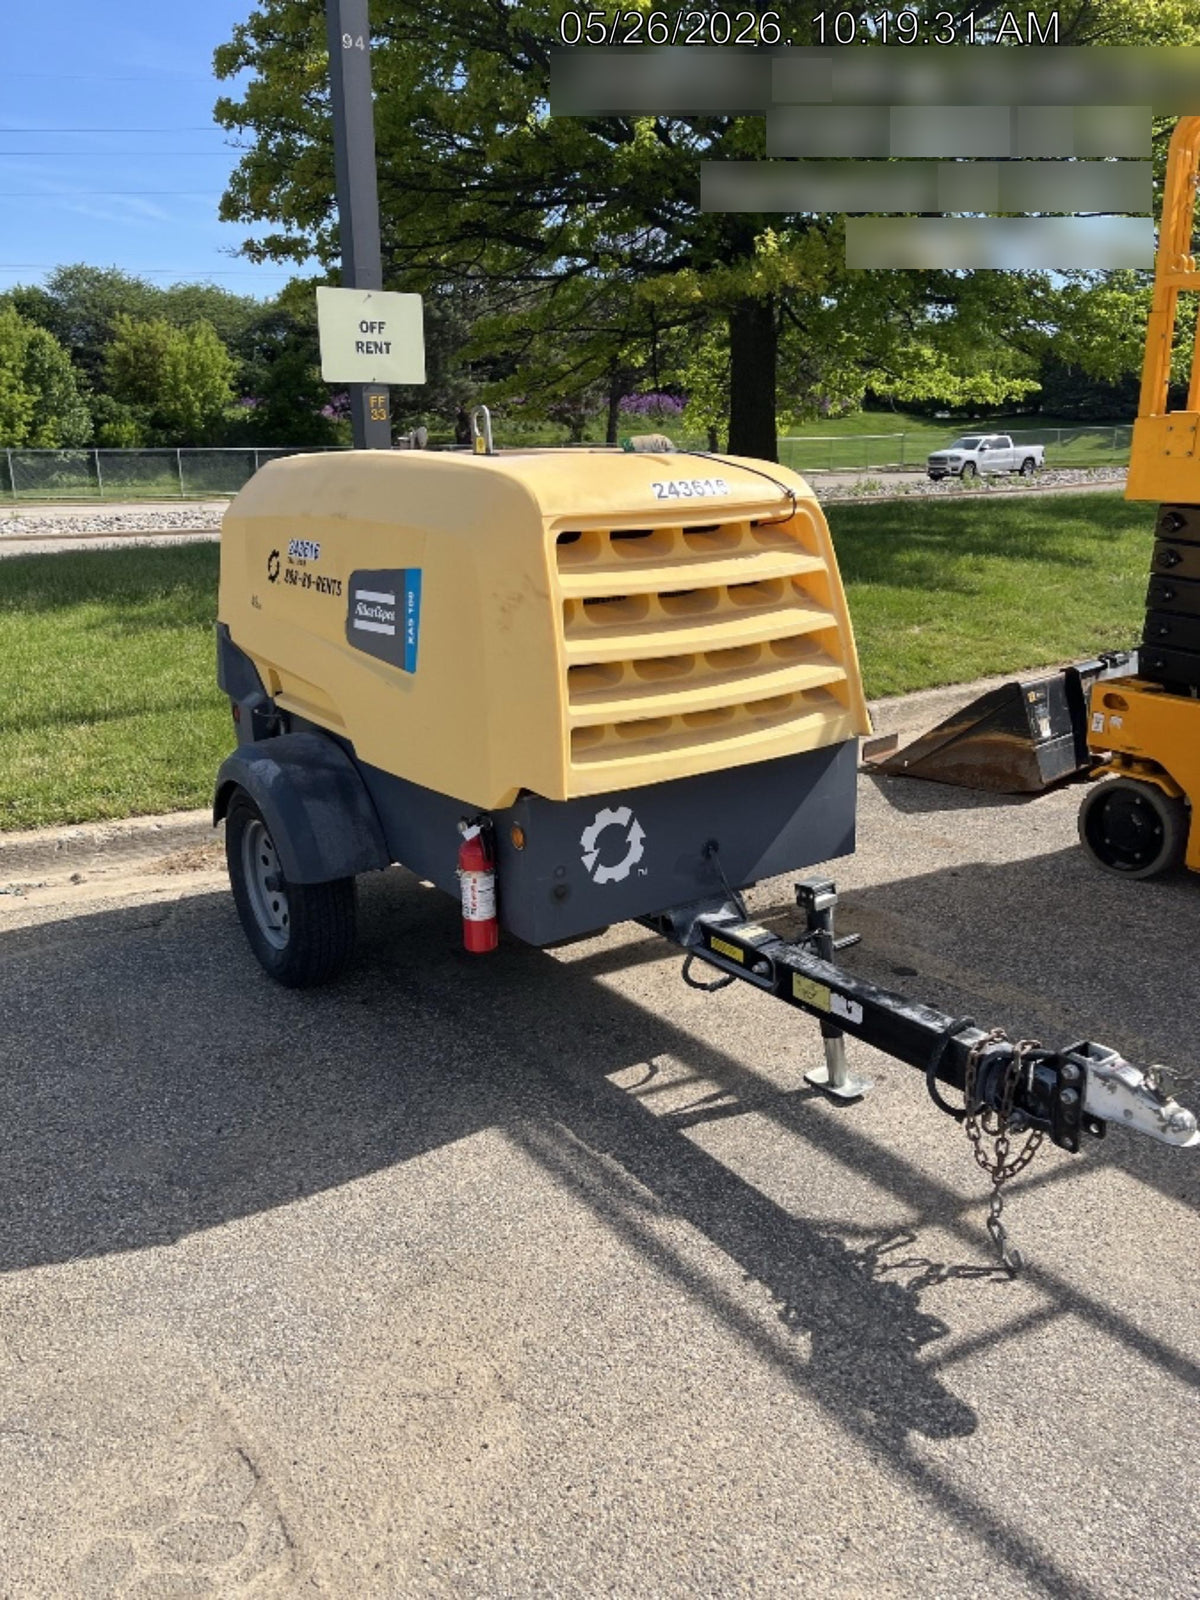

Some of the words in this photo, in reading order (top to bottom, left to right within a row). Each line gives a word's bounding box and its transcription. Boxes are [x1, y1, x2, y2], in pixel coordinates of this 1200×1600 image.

[342, 33, 365, 51] 94
[359, 320, 386, 334] OFF
[356, 341, 392, 355] RENT
[369, 395, 386, 408] FF
[370, 408, 387, 421] 33
